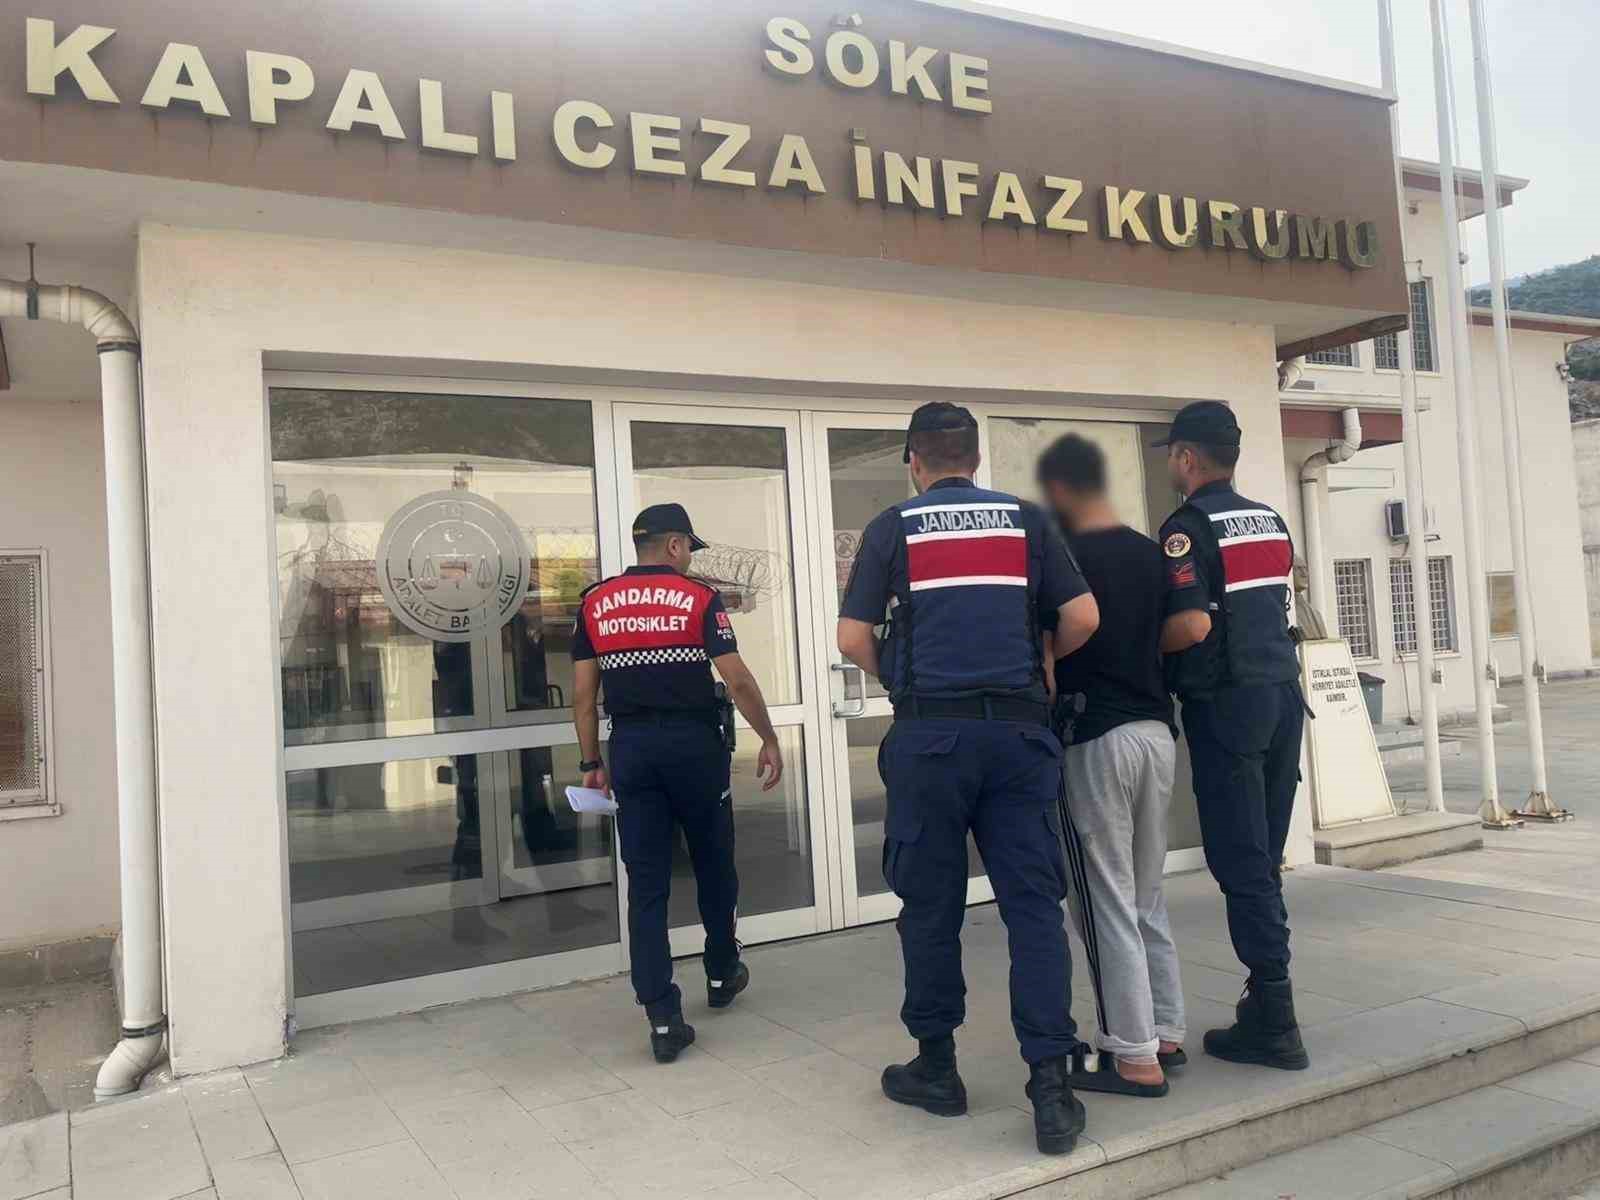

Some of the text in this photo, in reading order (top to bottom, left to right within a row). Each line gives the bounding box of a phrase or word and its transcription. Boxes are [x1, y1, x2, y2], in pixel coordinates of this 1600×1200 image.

[764, 12, 992, 114] SÖKE
[25, 17, 1381, 270] KAPALI CEZA İNFAZ KURUMU
[917, 509, 1014, 533] JANDARMA
[1223, 514, 1280, 538] JANDARMA
[592, 586, 696, 620] JANDARMA
